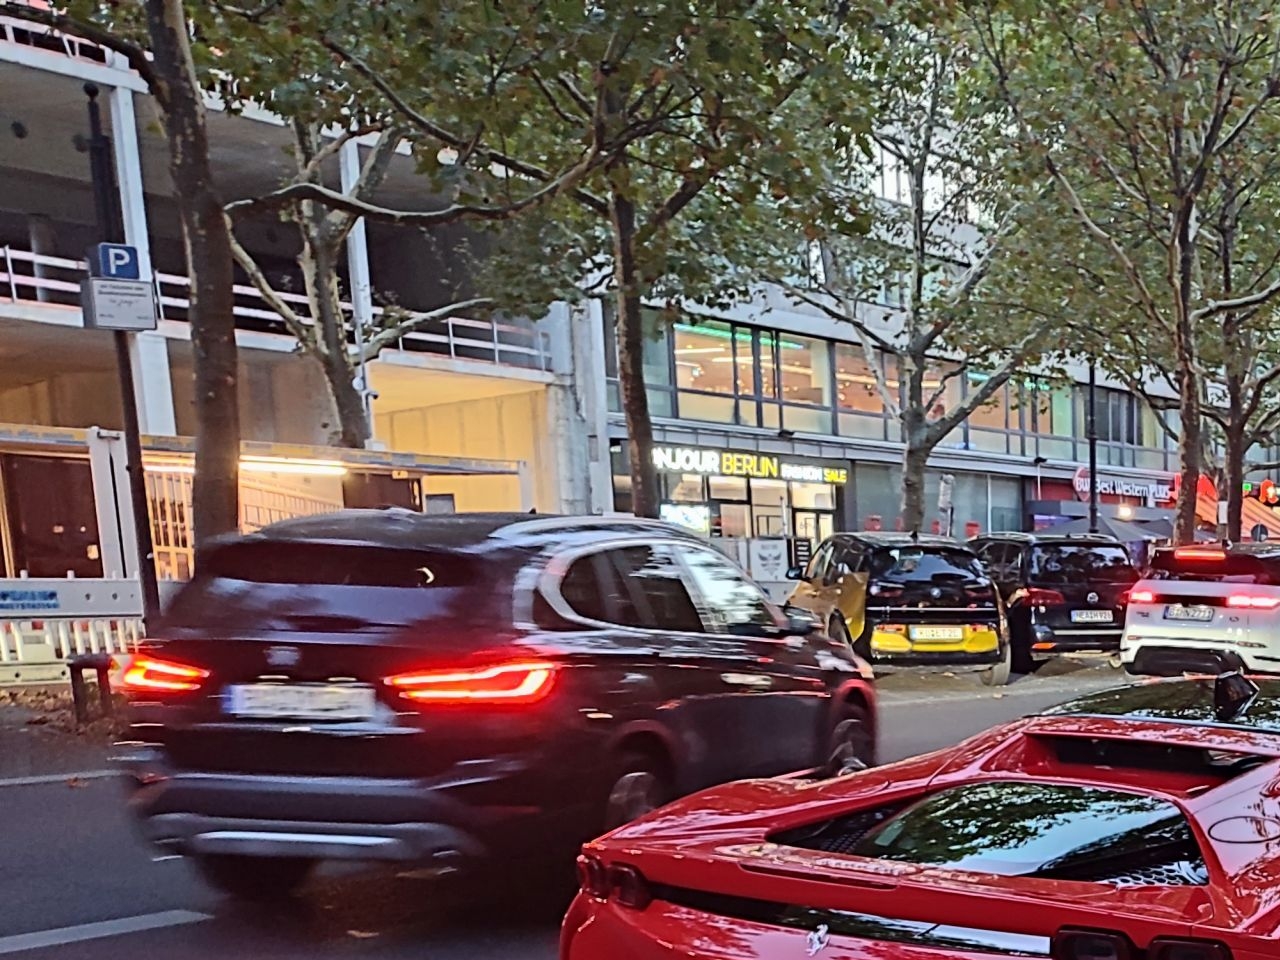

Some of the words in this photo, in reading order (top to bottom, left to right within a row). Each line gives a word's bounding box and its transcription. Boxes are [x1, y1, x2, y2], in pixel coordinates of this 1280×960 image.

[108, 248, 130, 275] P
[652, 448, 720, 473] NJOUR
[721, 452, 778, 478] BERLIN
[823, 467, 848, 484] SALE
[1114, 480, 1149, 497] Western
